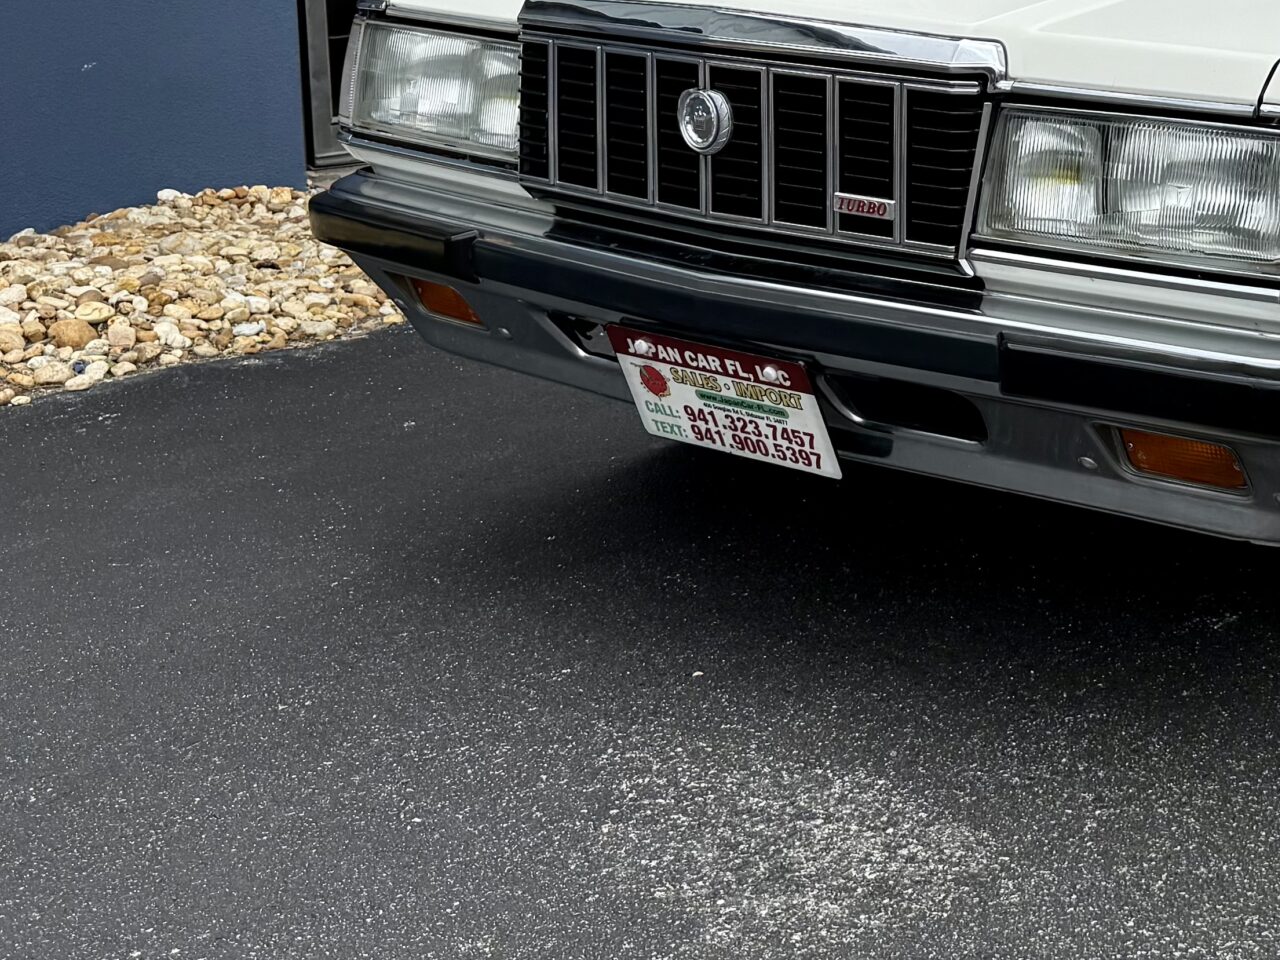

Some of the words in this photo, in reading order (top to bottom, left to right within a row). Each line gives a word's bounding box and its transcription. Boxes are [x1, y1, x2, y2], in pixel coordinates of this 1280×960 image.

[837, 197, 888, 217] TURBO
[627, 337, 682, 365] JPAN
[684, 350, 724, 374] CAR
[725, 359, 755, 382] FL,
[755, 365, 792, 387] LC
[644, 400, 681, 420] CALL:
[669, 366, 723, 392] SALES
[731, 380, 804, 411] IMPORT
[652, 419, 688, 439] TEXT:
[683, 404, 816, 450] 941.323.7457
[690, 424, 822, 470] 941.900.5397
